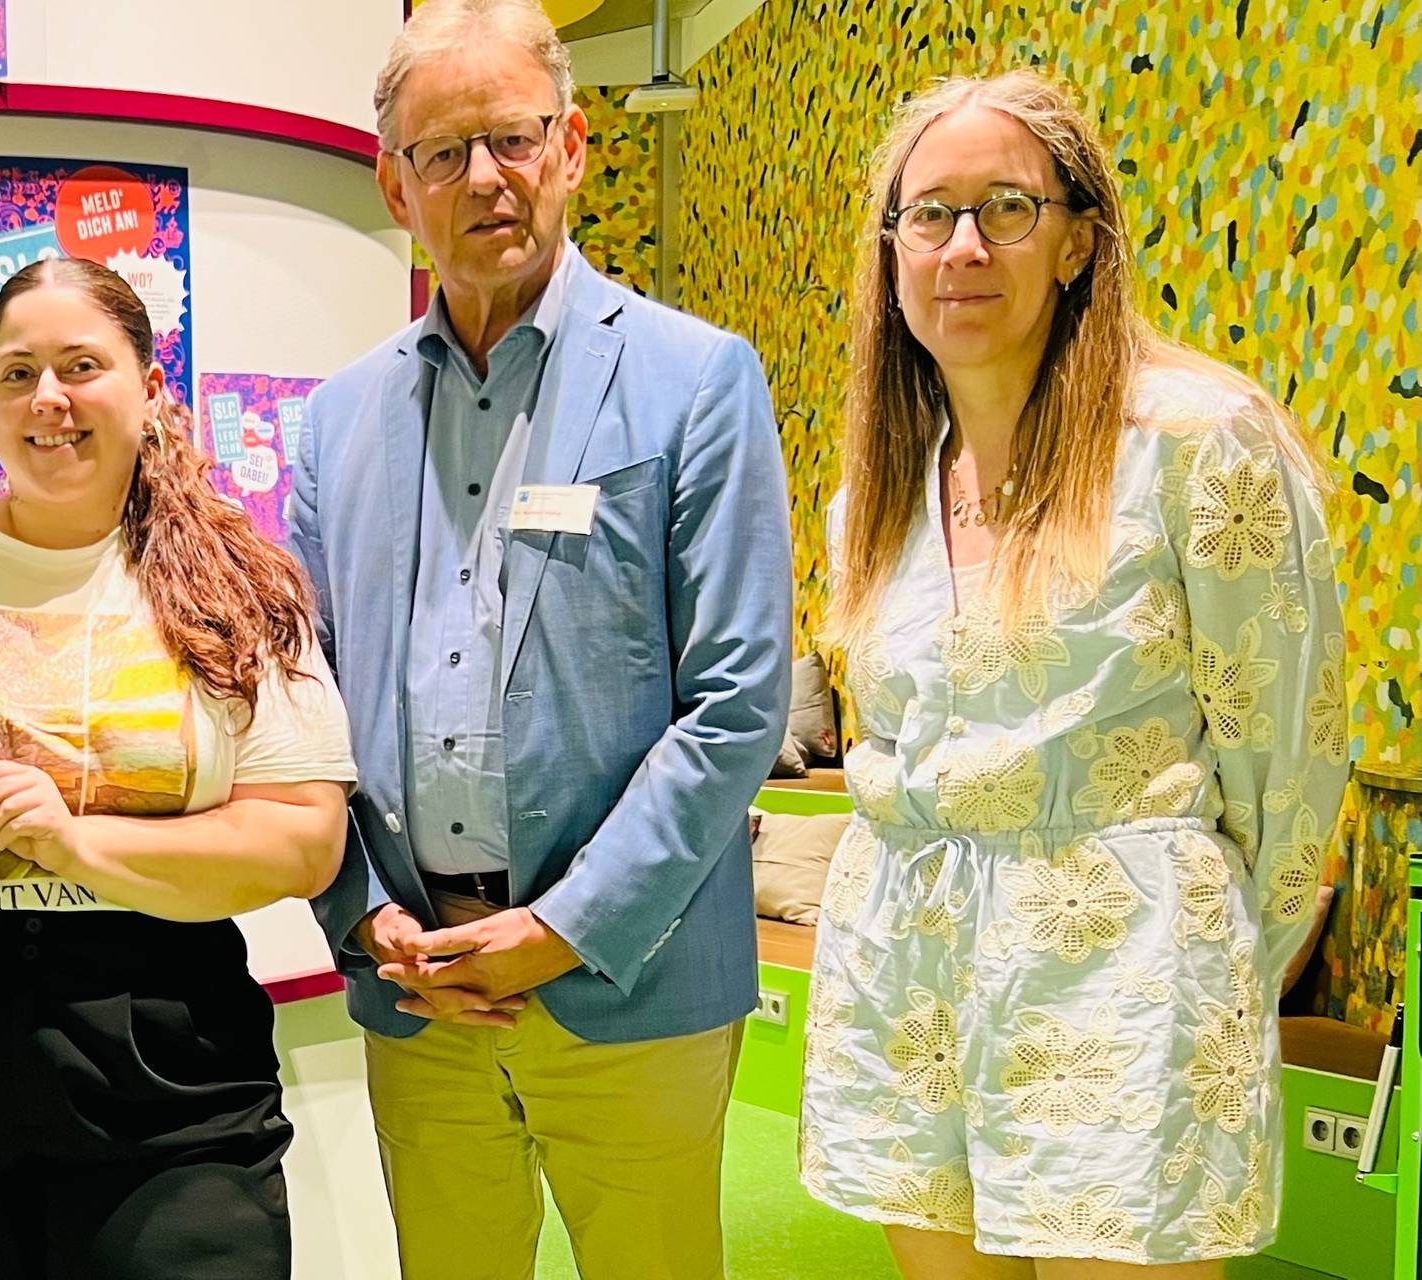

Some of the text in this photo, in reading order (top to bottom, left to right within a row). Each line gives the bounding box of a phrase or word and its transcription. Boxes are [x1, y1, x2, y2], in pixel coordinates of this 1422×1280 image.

[81, 188, 123, 216] MELD'
[76, 209, 139, 240] DICH AN!
[128, 272, 153, 288] WO?
[214, 401, 237, 419] SLC
[249, 454, 263, 467] SEI
[32, 882, 97, 907] VAN
